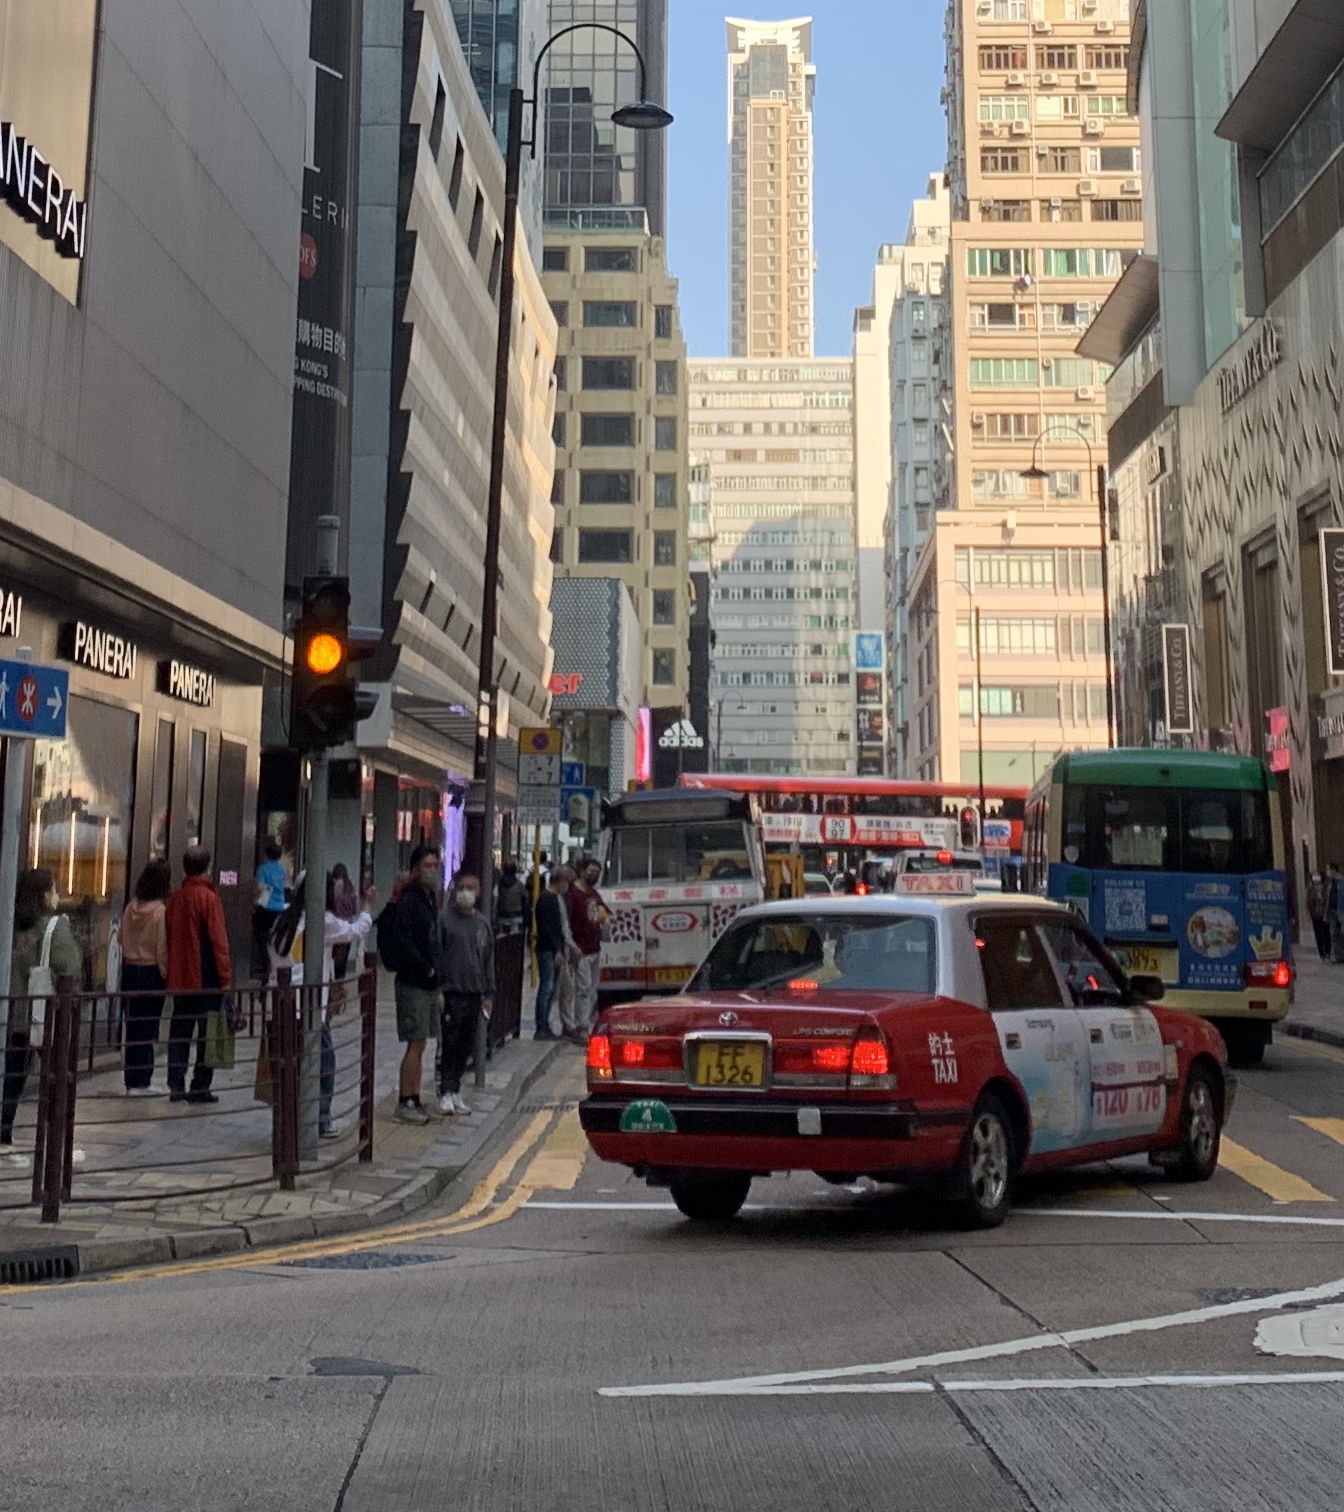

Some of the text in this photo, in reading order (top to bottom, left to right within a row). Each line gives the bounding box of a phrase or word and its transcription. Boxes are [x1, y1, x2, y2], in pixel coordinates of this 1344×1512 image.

[74, 621, 138, 681] PANERAI
[169, 659, 218, 707] PANERAI
[901, 875, 965, 891] TAXI
[929, 1032, 955, 1056] 的士
[706, 1064, 753, 1084] 1326
[932, 1058, 958, 1085] TAXI
